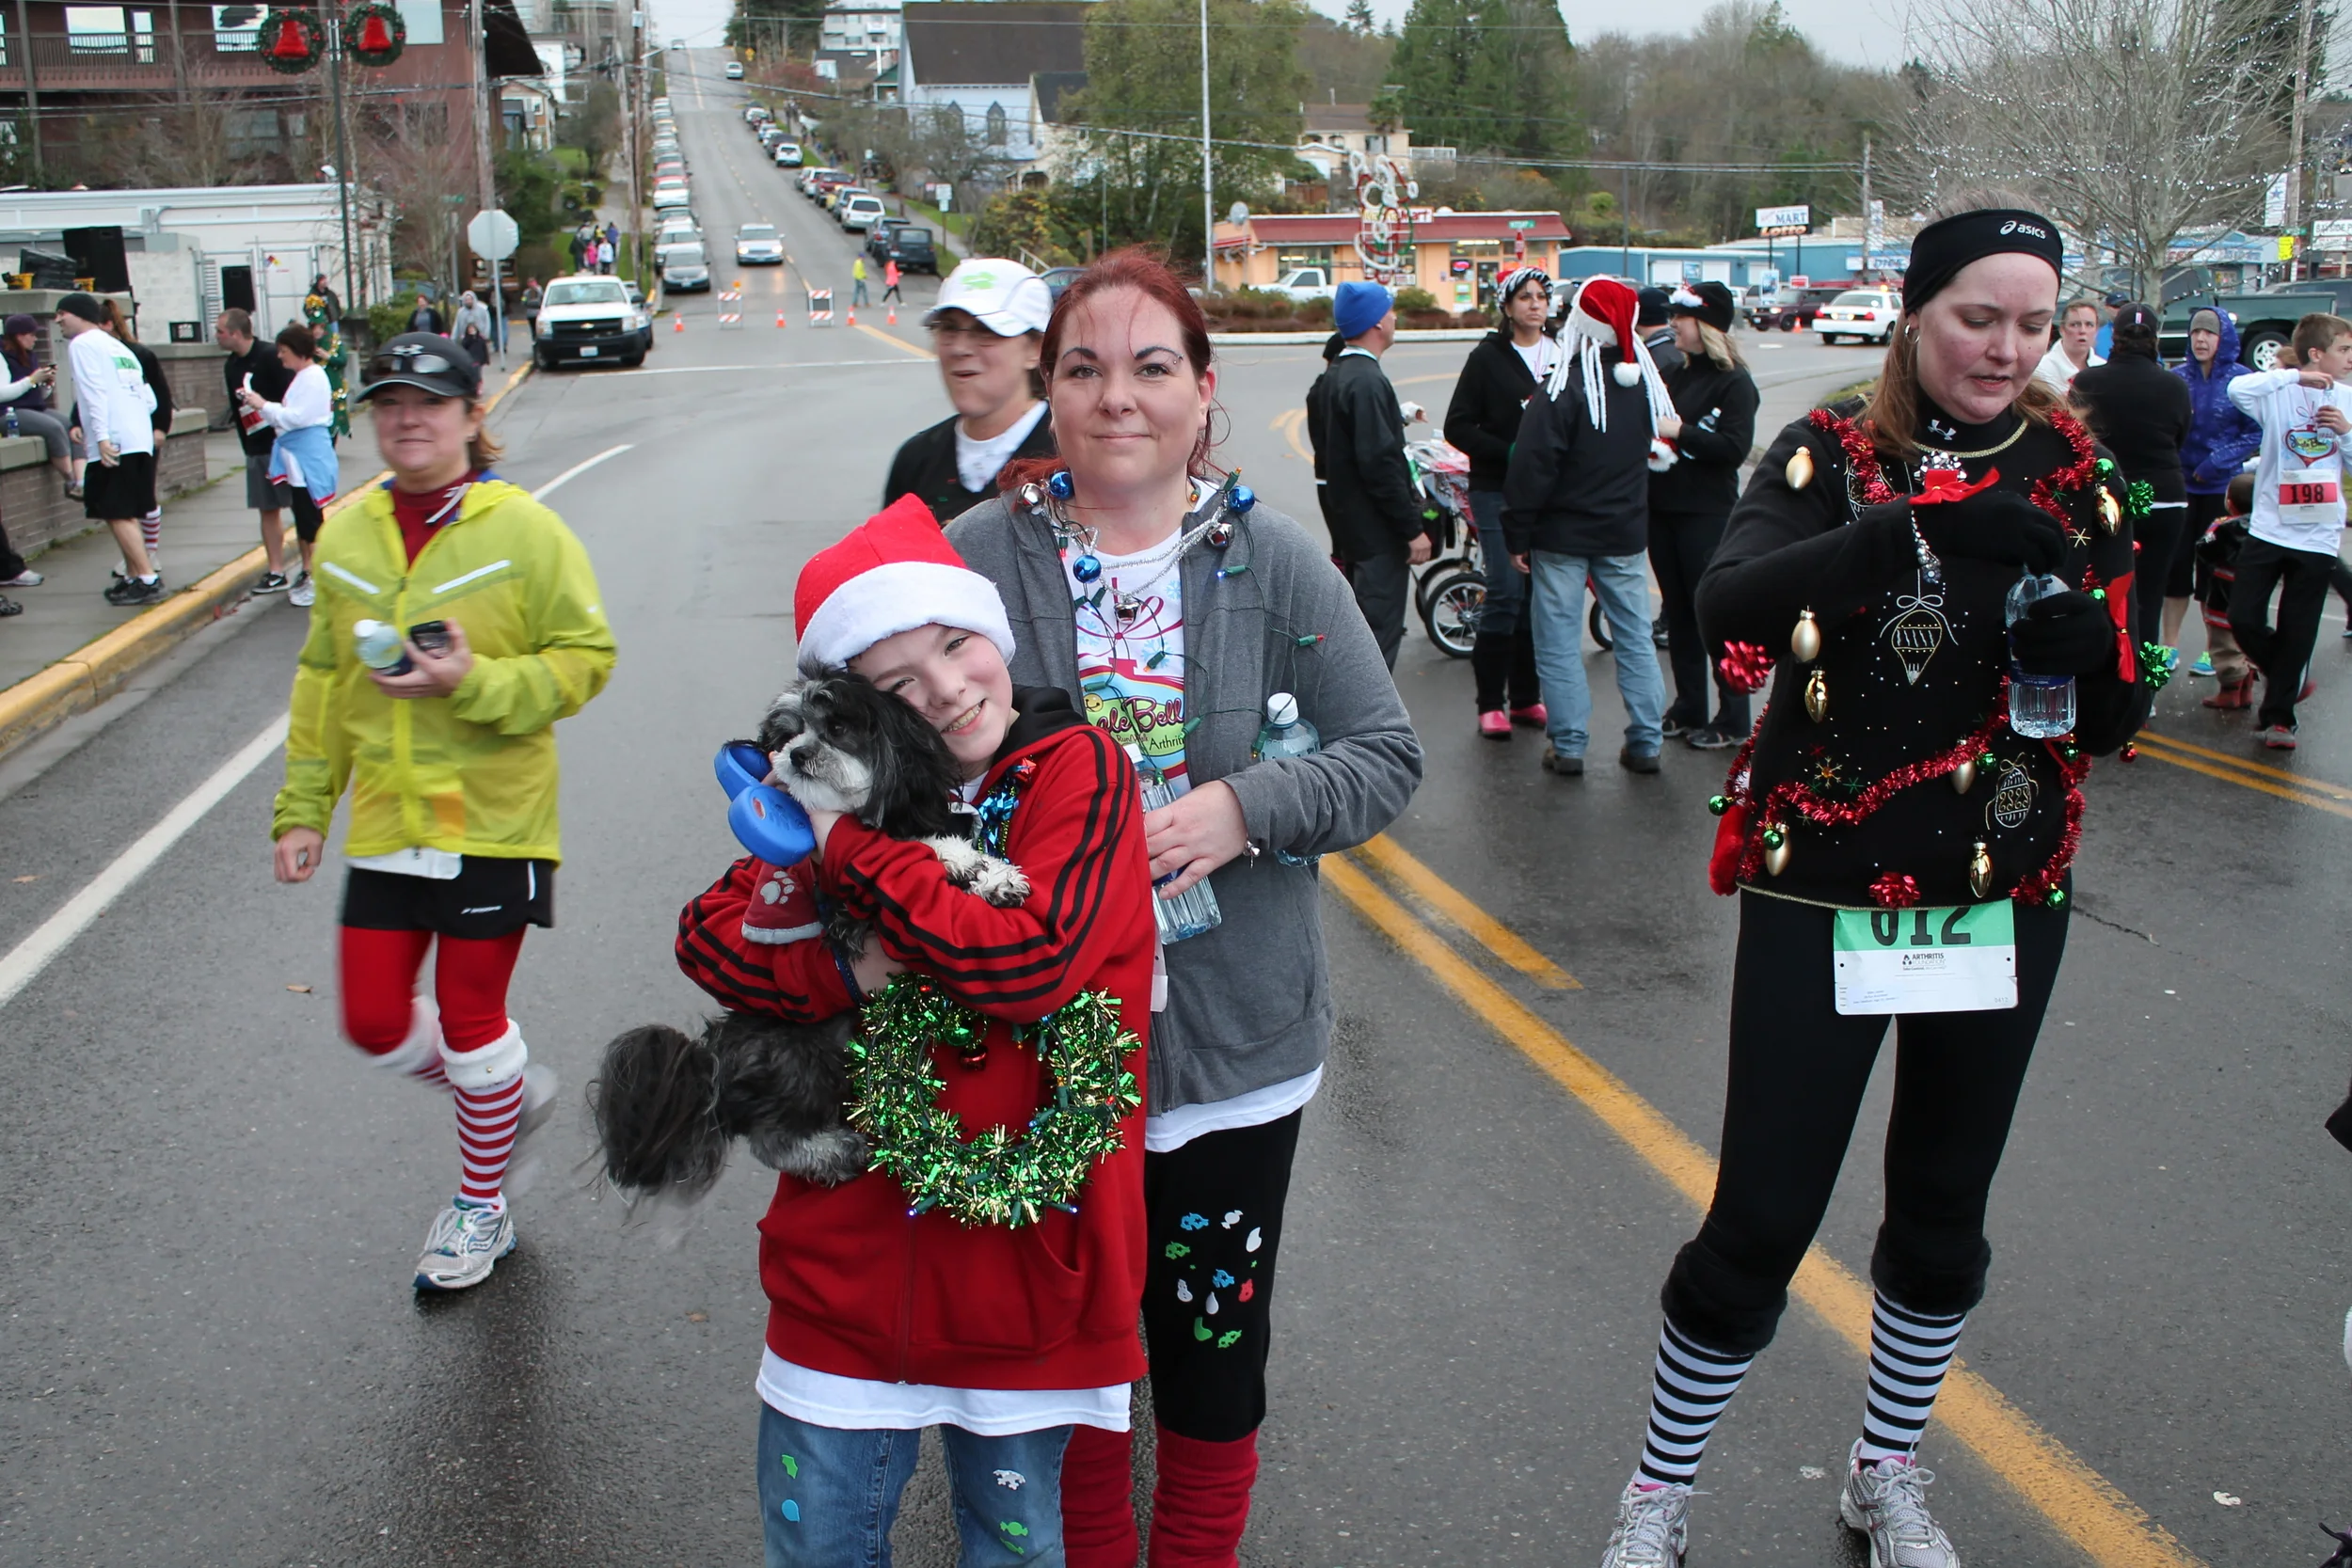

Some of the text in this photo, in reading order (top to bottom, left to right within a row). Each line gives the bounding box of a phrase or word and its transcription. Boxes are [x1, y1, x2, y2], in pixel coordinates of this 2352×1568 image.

[1775, 212, 1806, 224] MART
[1760, 225, 1807, 236] Lotto
[2017, 224, 2046, 239] asics
[2291, 483, 2324, 504] 198
[1122, 695, 1184, 733] Bell
[1912, 952, 1945, 960] ARTHRITIS
